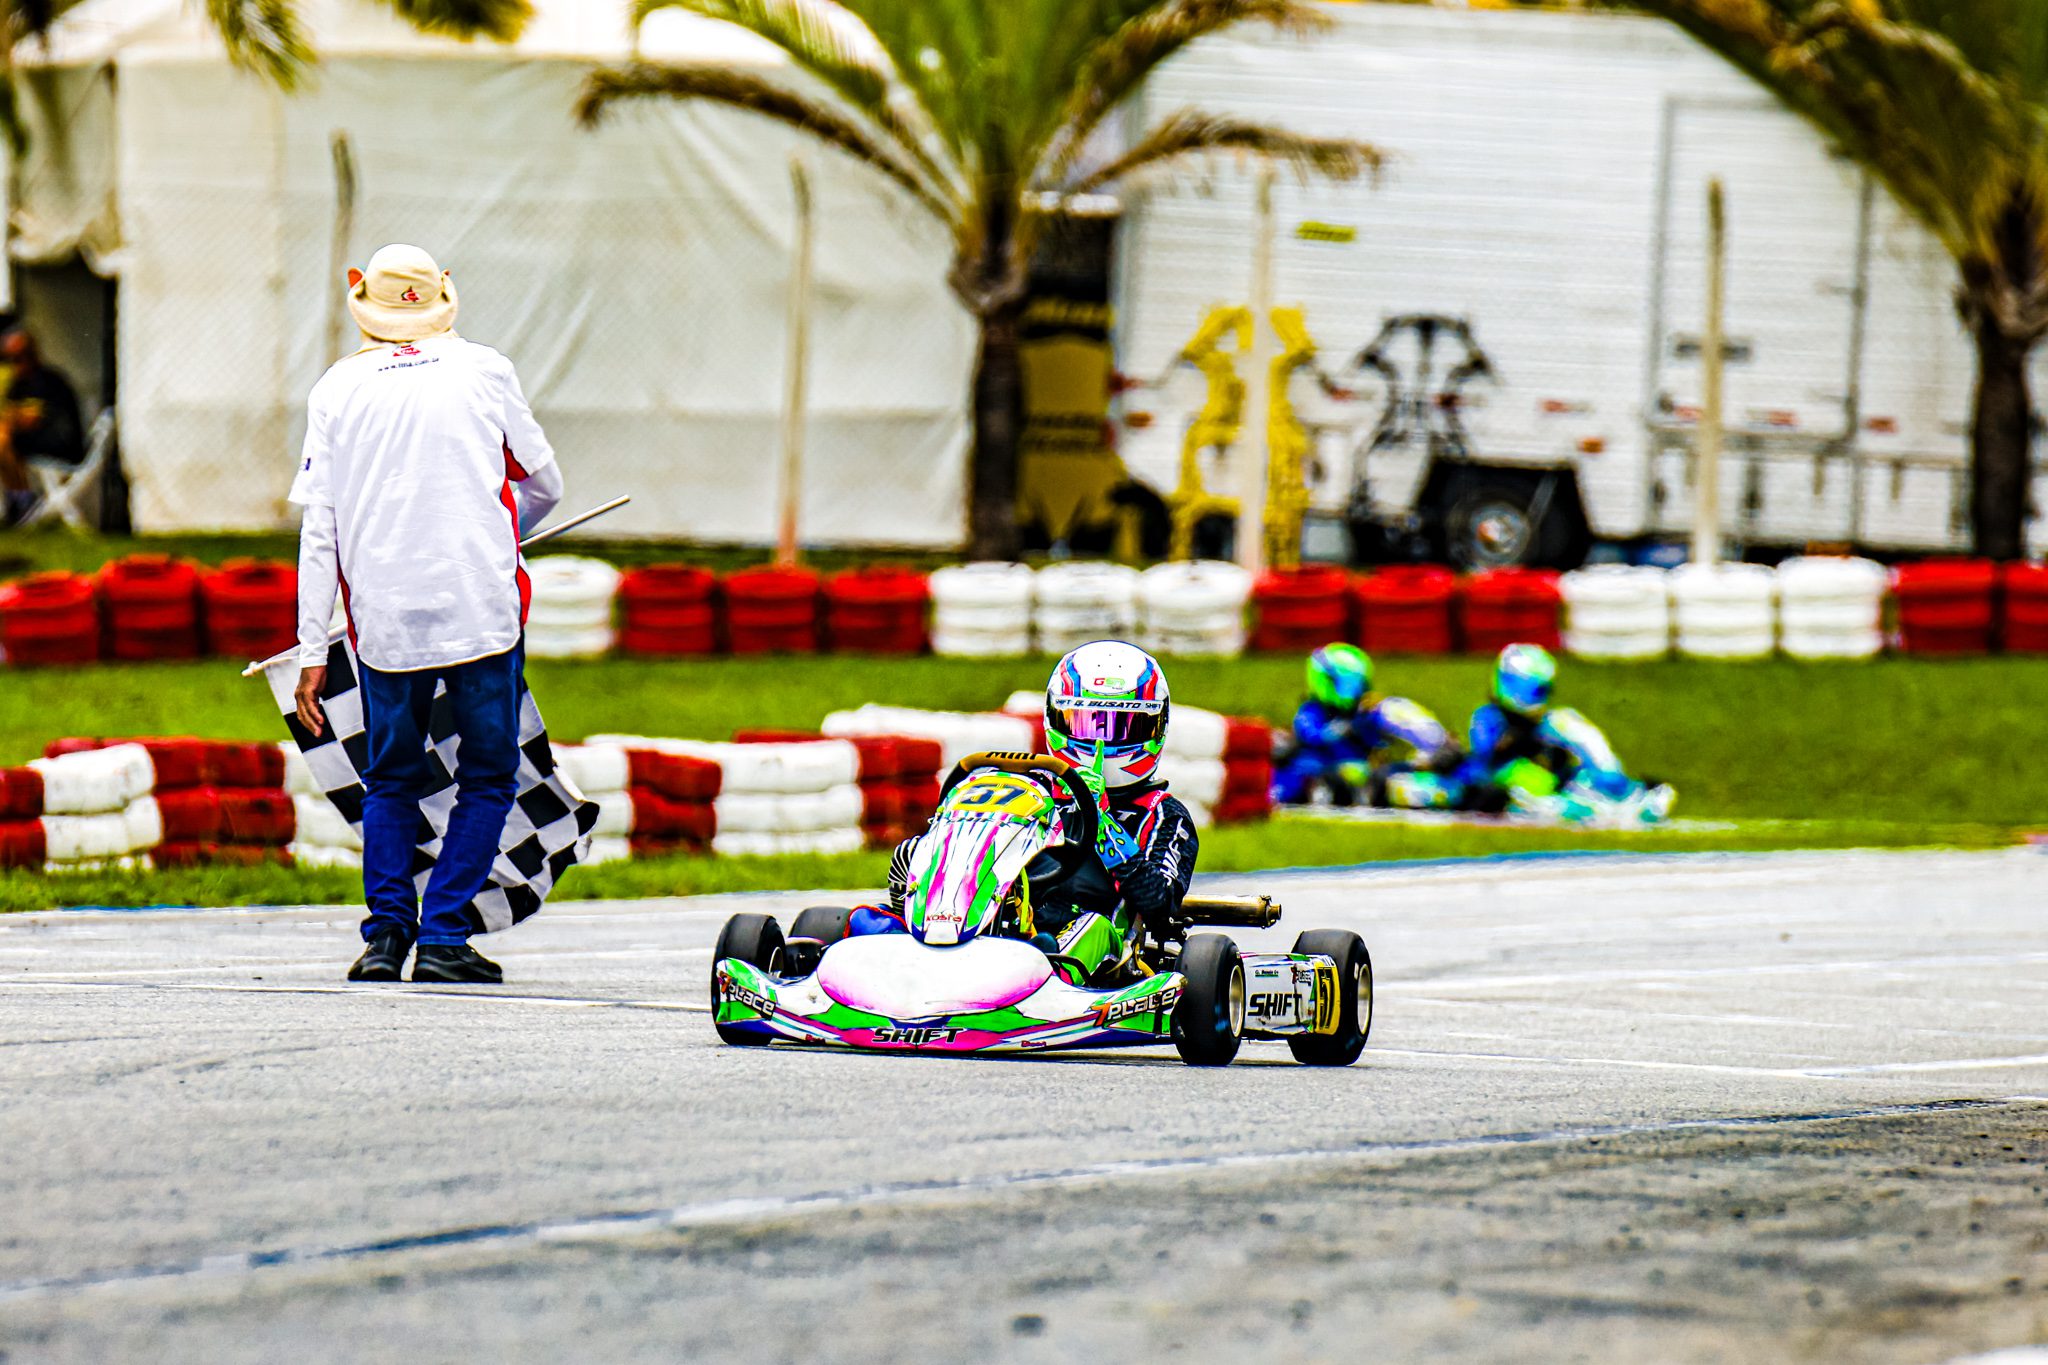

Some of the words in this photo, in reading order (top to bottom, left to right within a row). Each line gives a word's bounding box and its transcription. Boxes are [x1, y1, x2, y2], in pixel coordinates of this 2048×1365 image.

[1087, 700, 1141, 709] BUSATO
[1247, 993, 1302, 1017] SHIFT
[871, 1027, 964, 1043] SHIFT
